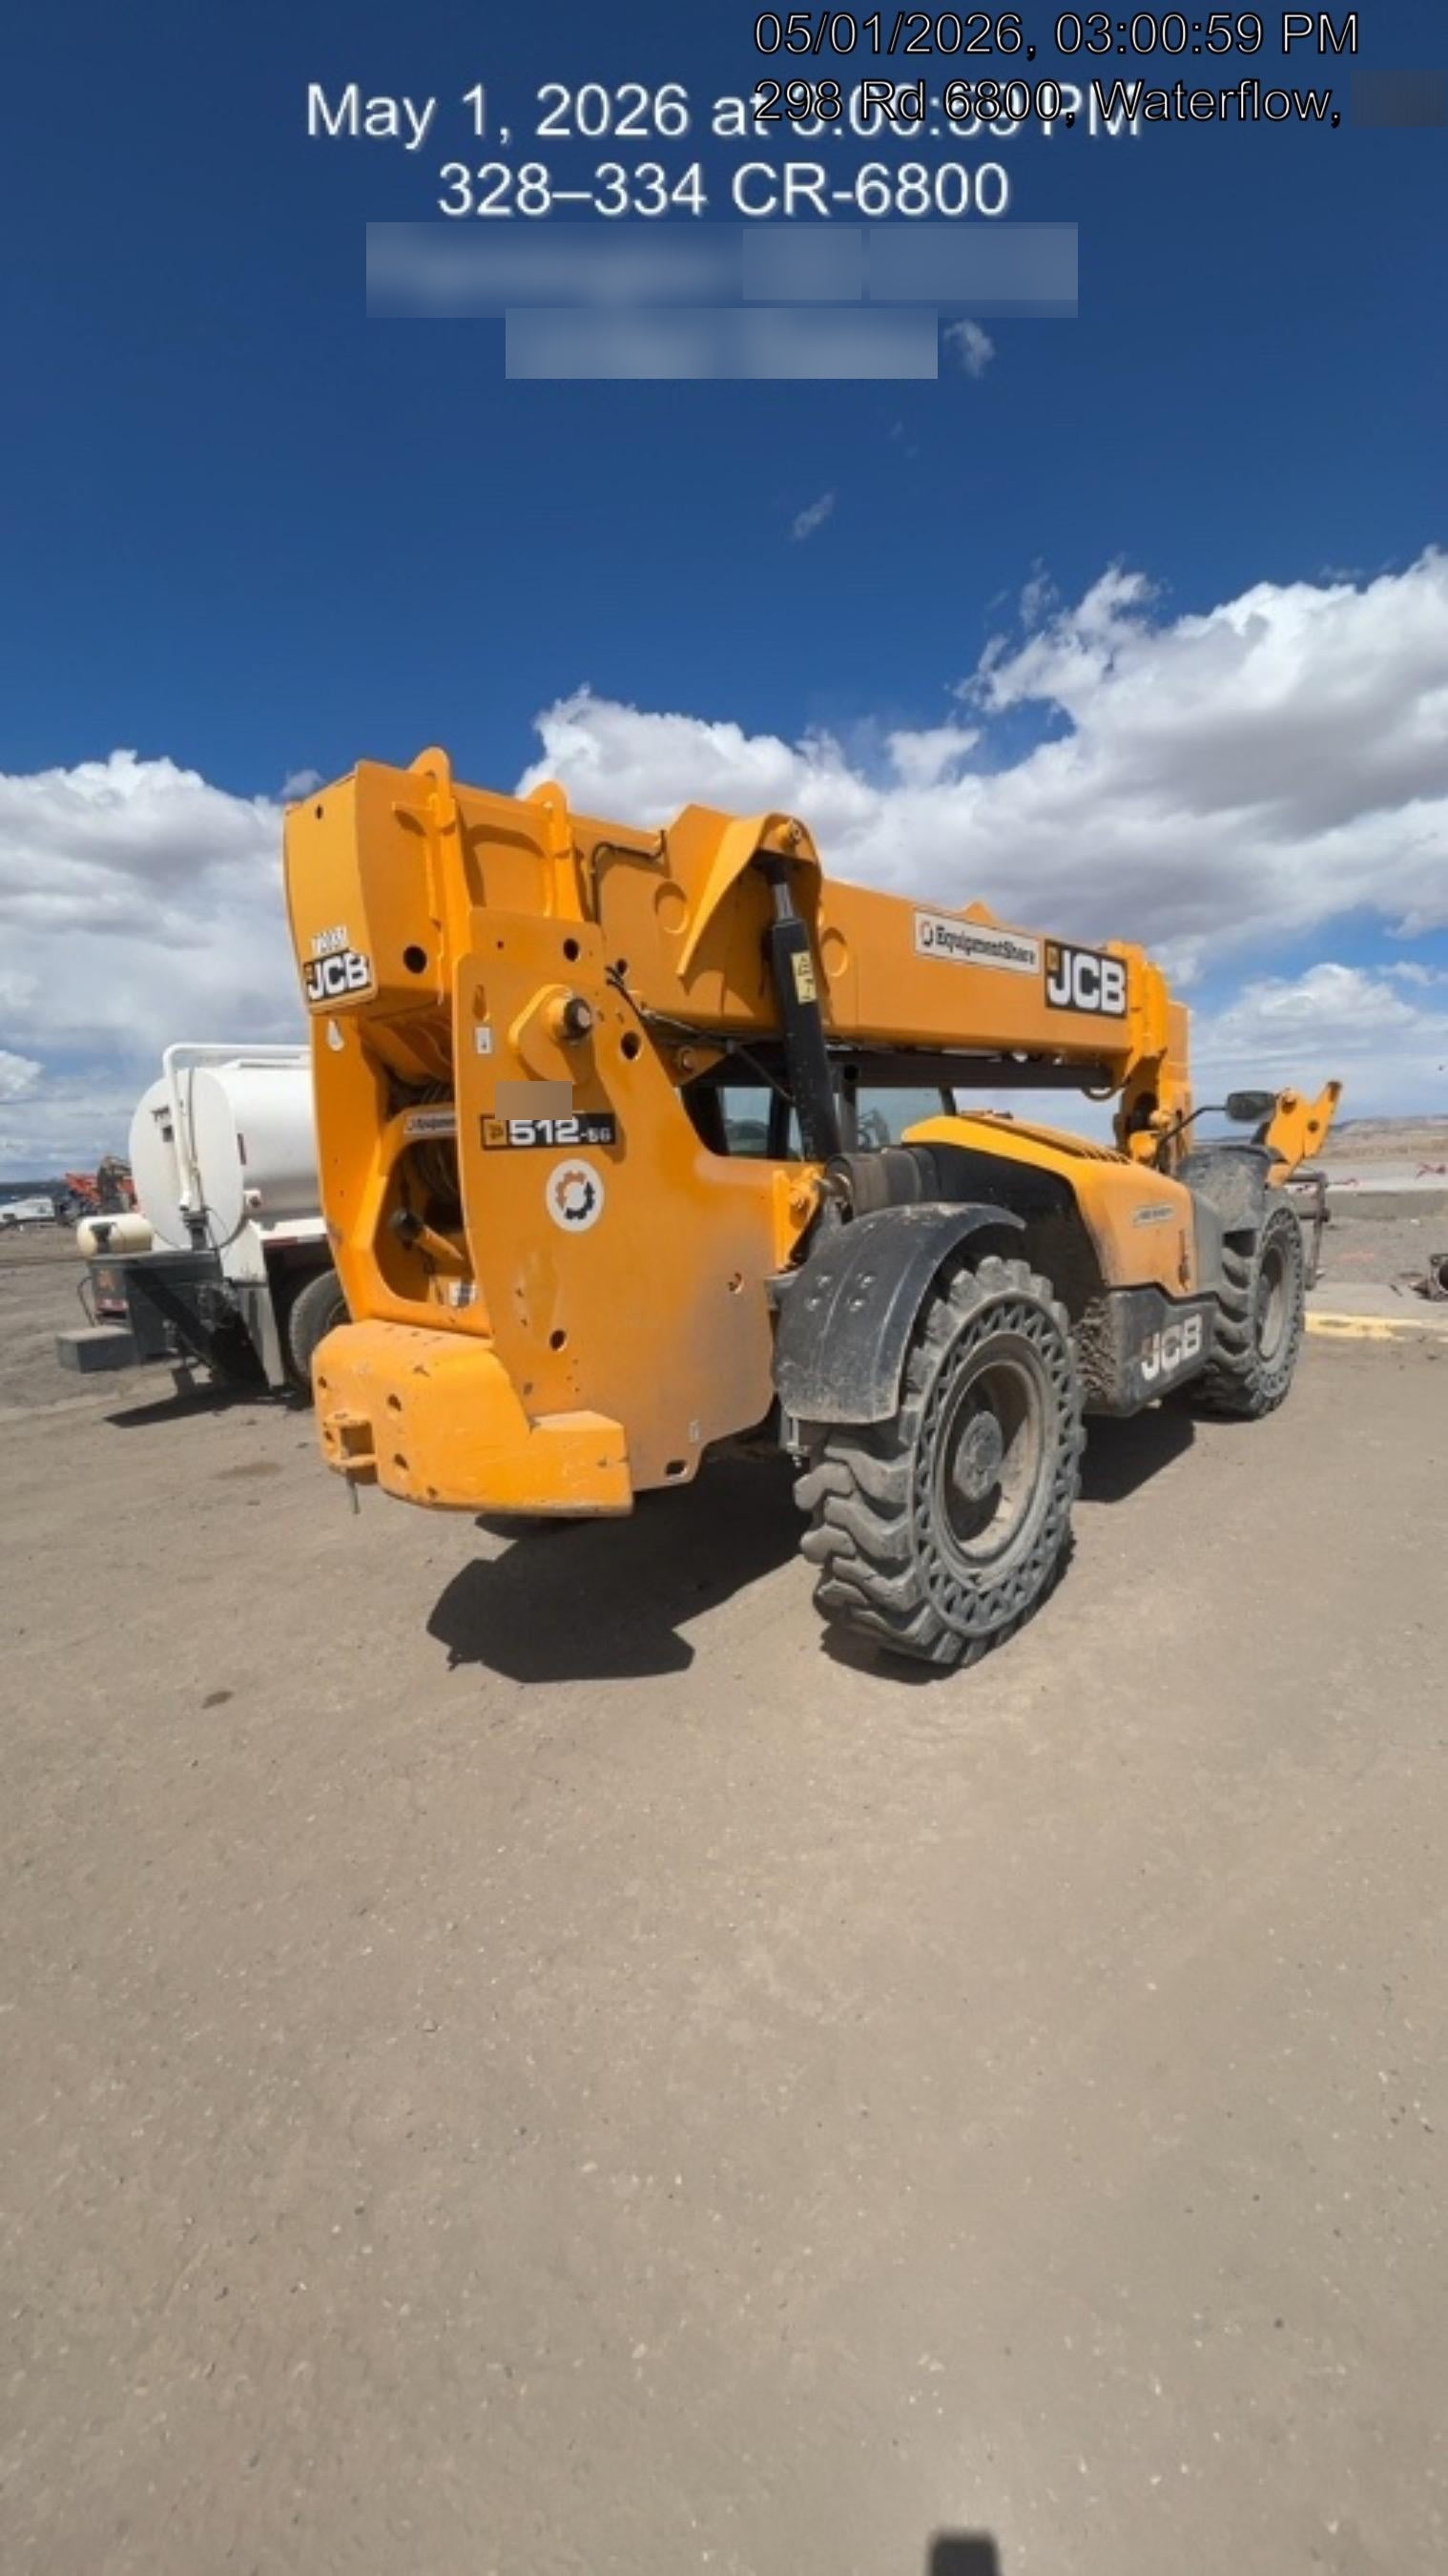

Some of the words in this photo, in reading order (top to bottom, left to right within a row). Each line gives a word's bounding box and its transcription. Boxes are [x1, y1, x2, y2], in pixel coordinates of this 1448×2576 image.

[935, 924, 1036, 966] EquipmentShare
[307, 951, 369, 1001] JCB
[1046, 949, 1126, 1015] JCB
[1141, 1313, 1203, 1381] JCB
